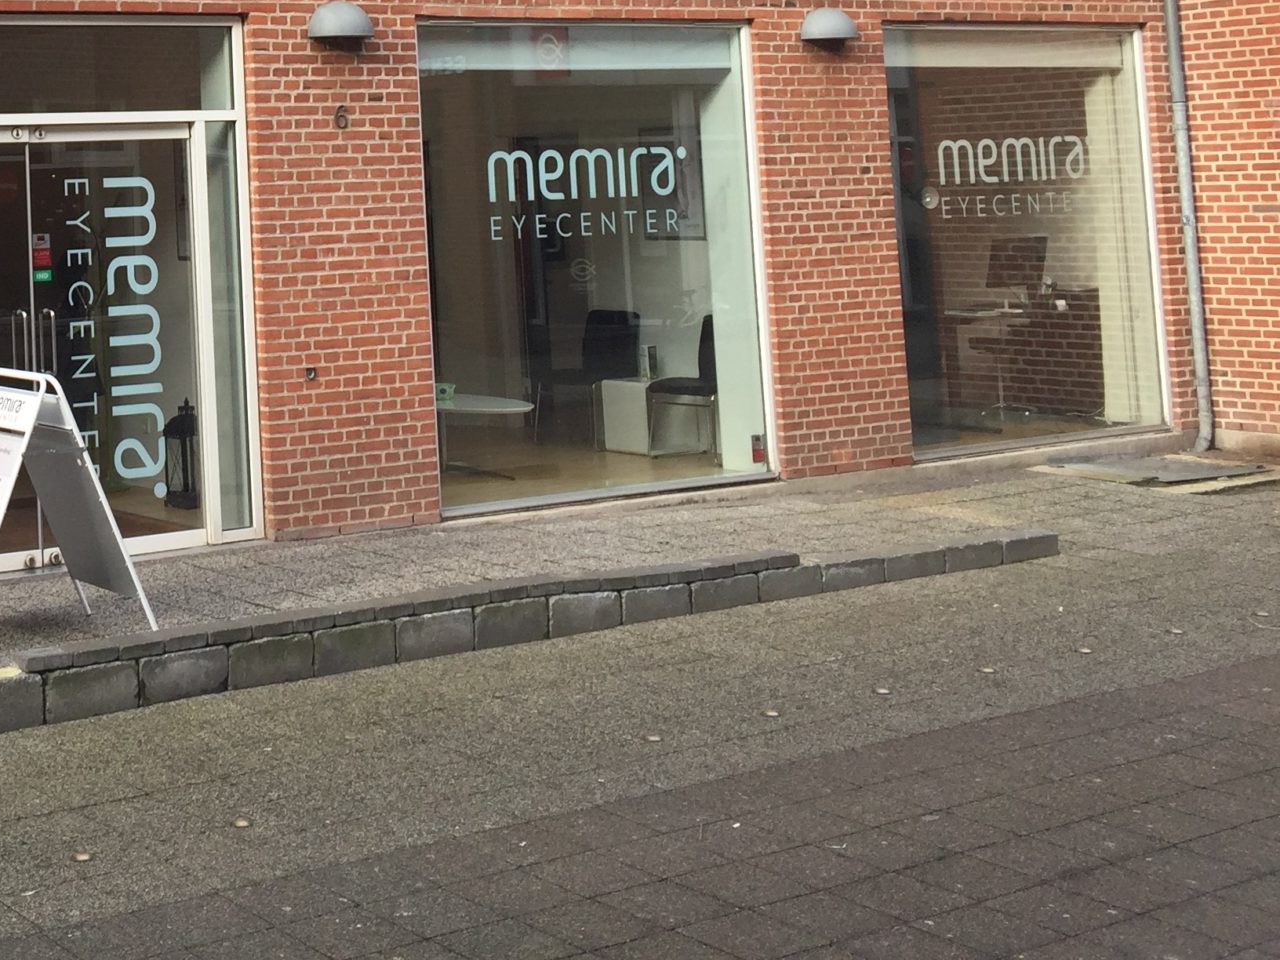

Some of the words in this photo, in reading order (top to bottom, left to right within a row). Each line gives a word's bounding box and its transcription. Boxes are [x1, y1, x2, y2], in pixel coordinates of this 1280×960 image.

[334, 105, 348, 129] 6
[487, 146, 687, 202] memira
[938, 135, 1089, 185] memira
[490, 208, 679, 240] EYECENTER
[942, 192, 1073, 219] EYECENTE
[103, 176, 167, 499] memira
